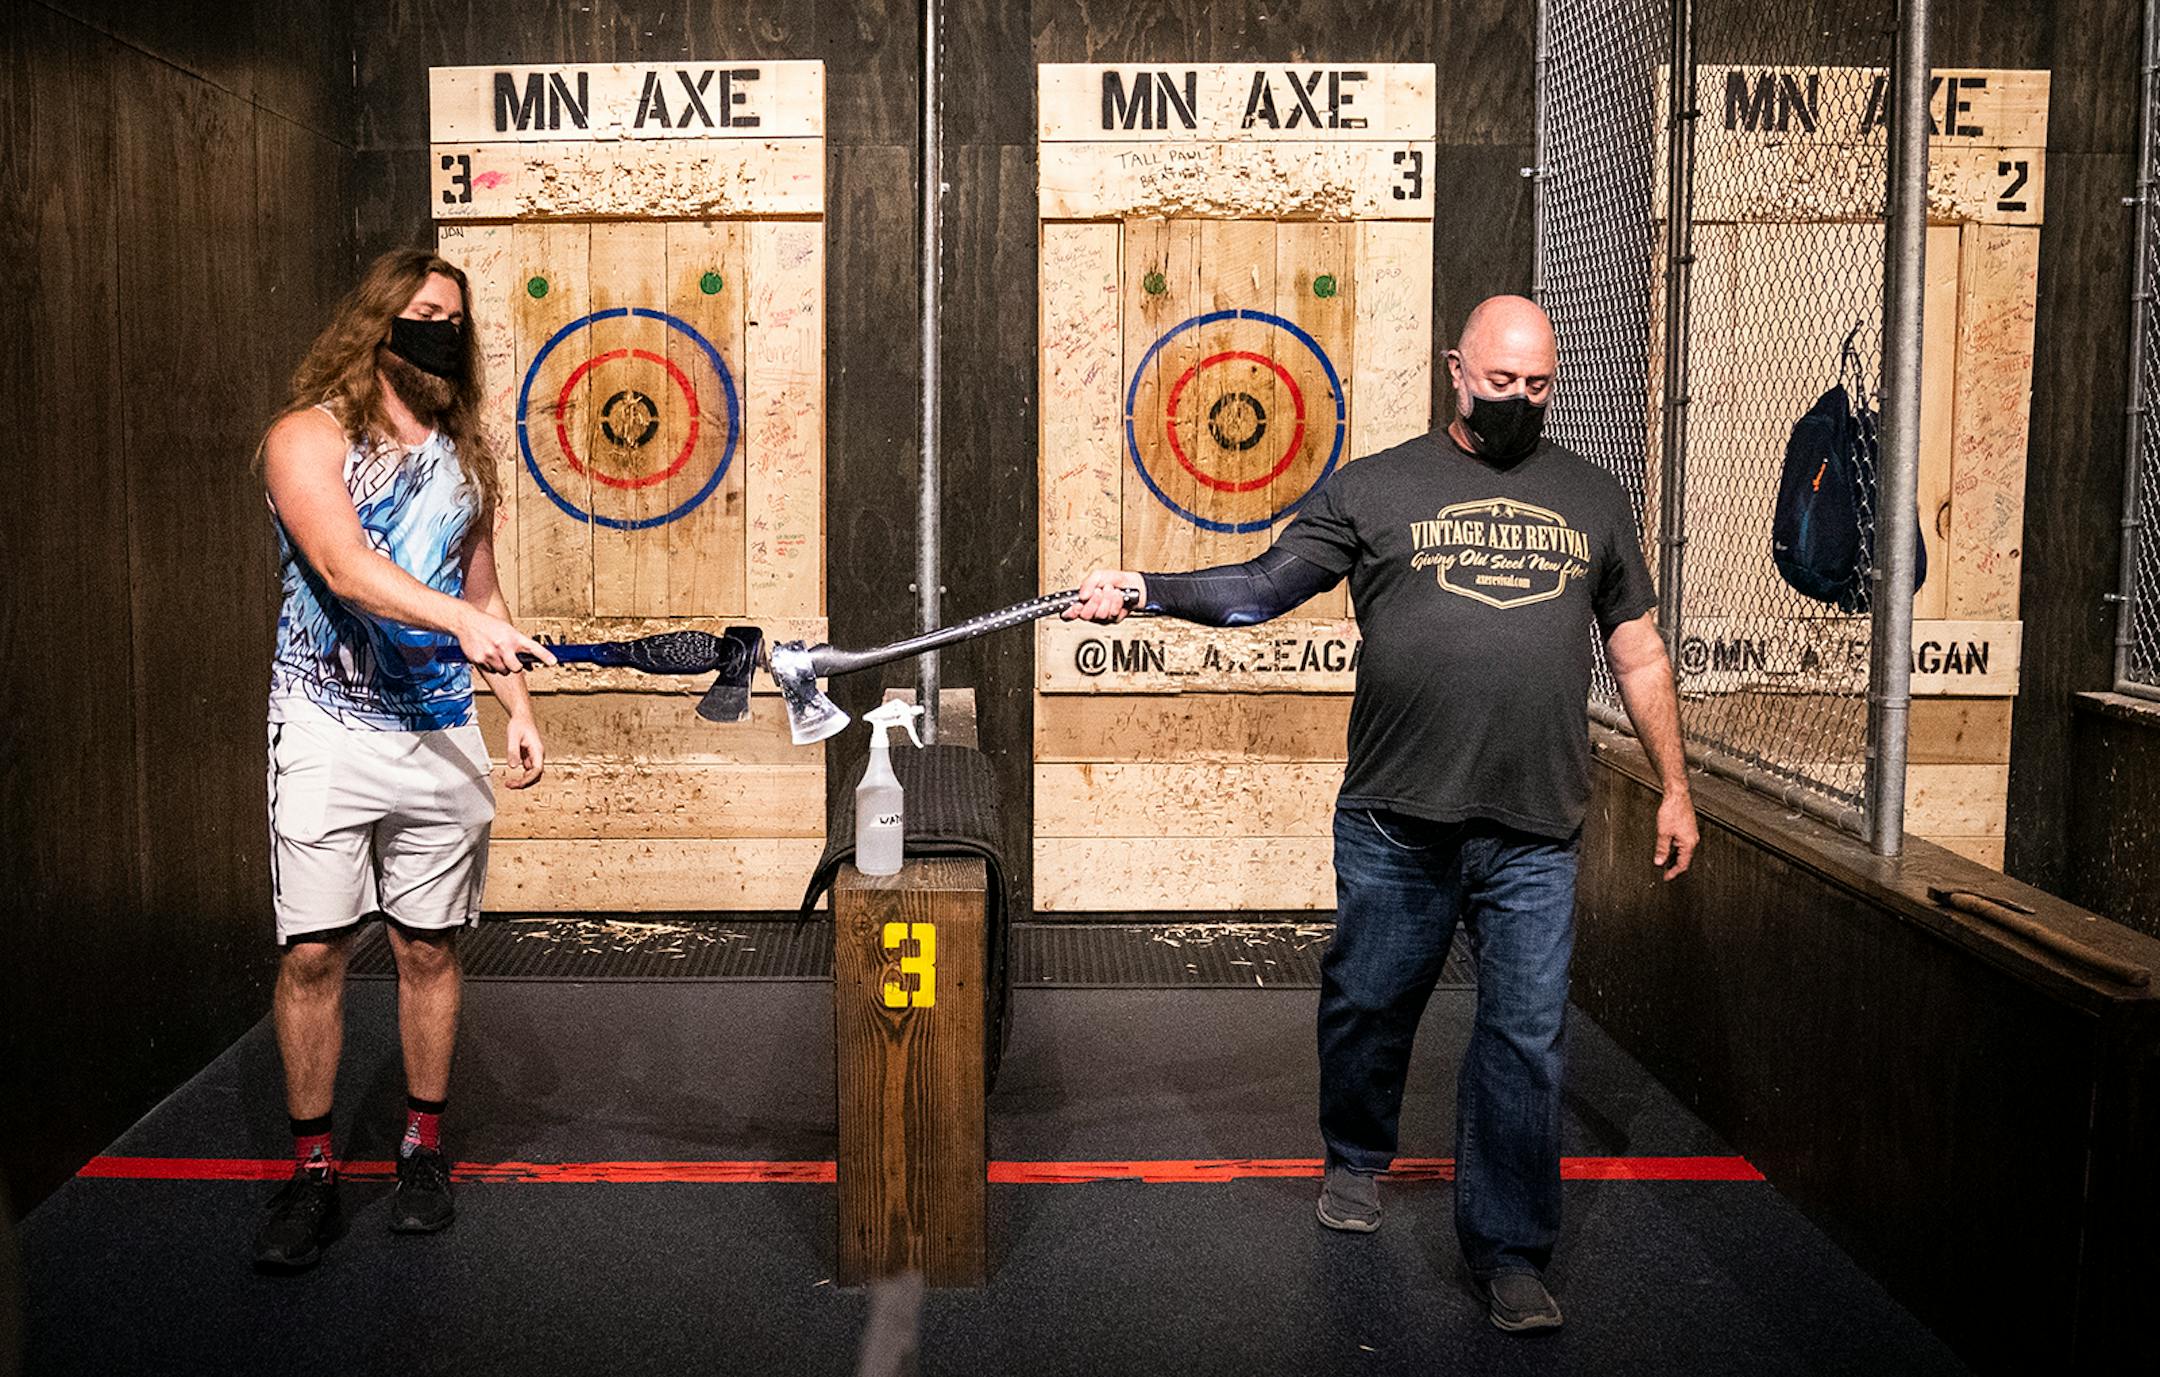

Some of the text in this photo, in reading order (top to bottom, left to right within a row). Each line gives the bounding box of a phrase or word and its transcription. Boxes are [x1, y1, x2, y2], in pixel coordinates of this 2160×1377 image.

[494, 69, 760, 131] MN AXE
[1101, 70, 1368, 130] MN AXE
[1725, 71, 1819, 133] MN
[441, 154, 472, 204] 3
[1113, 150, 1162, 169] TALL
[1393, 150, 1423, 200] 3
[1997, 160, 2029, 212] 2
[1410, 520, 1592, 563] VINTAGE AXE REVIVAL
[1410, 551, 1458, 571] Giving
[1459, 549, 1488, 567] Old
[1490, 555, 1526, 570] Steel
[1527, 553, 1561, 571] New
[1475, 574, 1531, 588] axerevival.com
[883, 922, 937, 1008] 3
